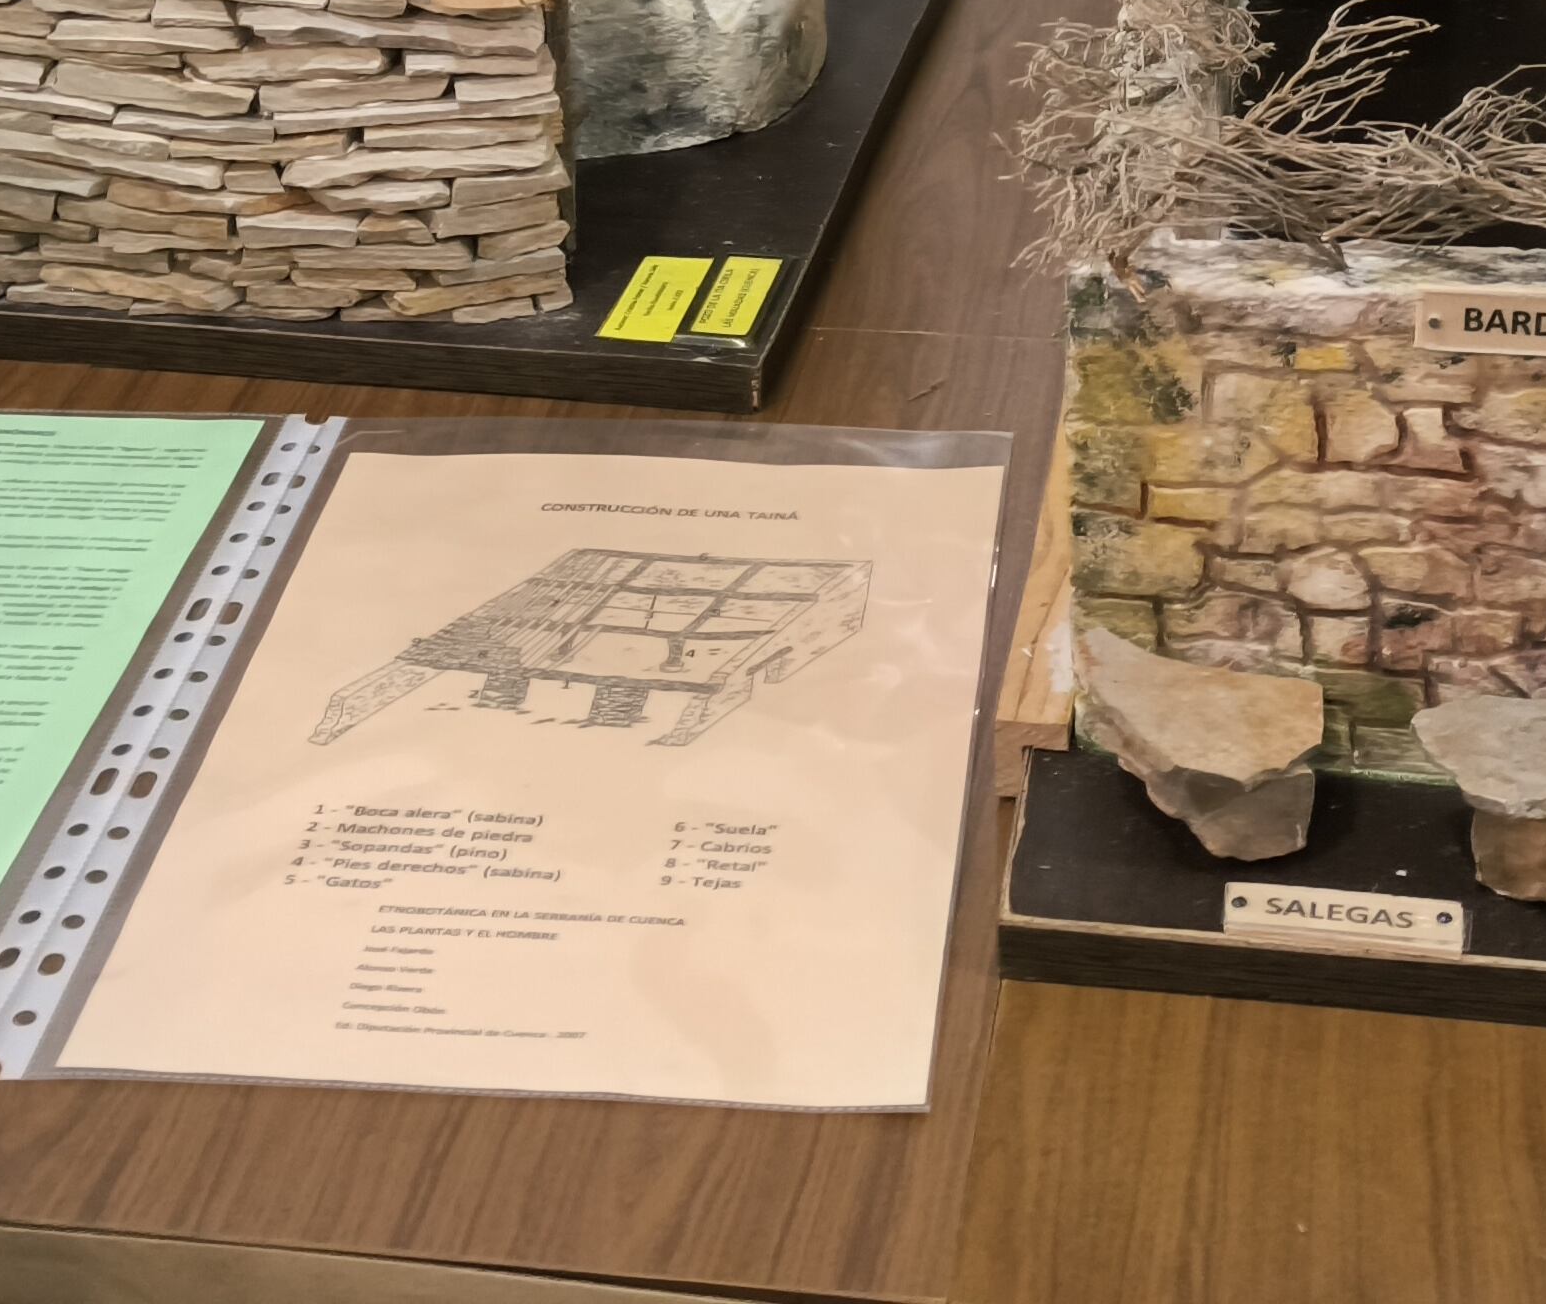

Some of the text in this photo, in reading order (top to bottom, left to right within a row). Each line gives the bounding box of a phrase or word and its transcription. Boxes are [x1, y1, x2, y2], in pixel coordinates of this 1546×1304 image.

[540, 502, 672, 516] CONSTRUCCIÓN
[676, 508, 699, 518] DE
[704, 509, 741, 519] UNA
[314, 804, 324, 815] 1
[467, 810, 544, 827] (sabina)
[306, 821, 318, 832] 2
[337, 823, 435, 837] Machones
[441, 826, 466, 838] de
[471, 829, 534, 843] piedra
[674, 821, 686, 832] 6
[299, 839, 311, 849] 3
[449, 845, 509, 861] (pino)
[670, 839, 682, 850] 7
[291, 856, 304, 867] 4
[482, 865, 562, 882] (sabina)
[664, 857, 676, 868] 8
[284, 874, 297, 885] 5
[660, 875, 672, 886] 9
[693, 876, 742, 890] Tejas
[491, 909, 510, 918] EN
[513, 910, 530, 919] LA
[606, 915, 625, 924] DE
[629, 915, 686, 927] CUENCA
[1265, 897, 1415, 929] SALEGAS
[371, 924, 395, 934] LAS
[399, 925, 461, 936] PLANTAS
[477, 929, 492, 938] EL
[495, 929, 558, 941] HOMBRE
